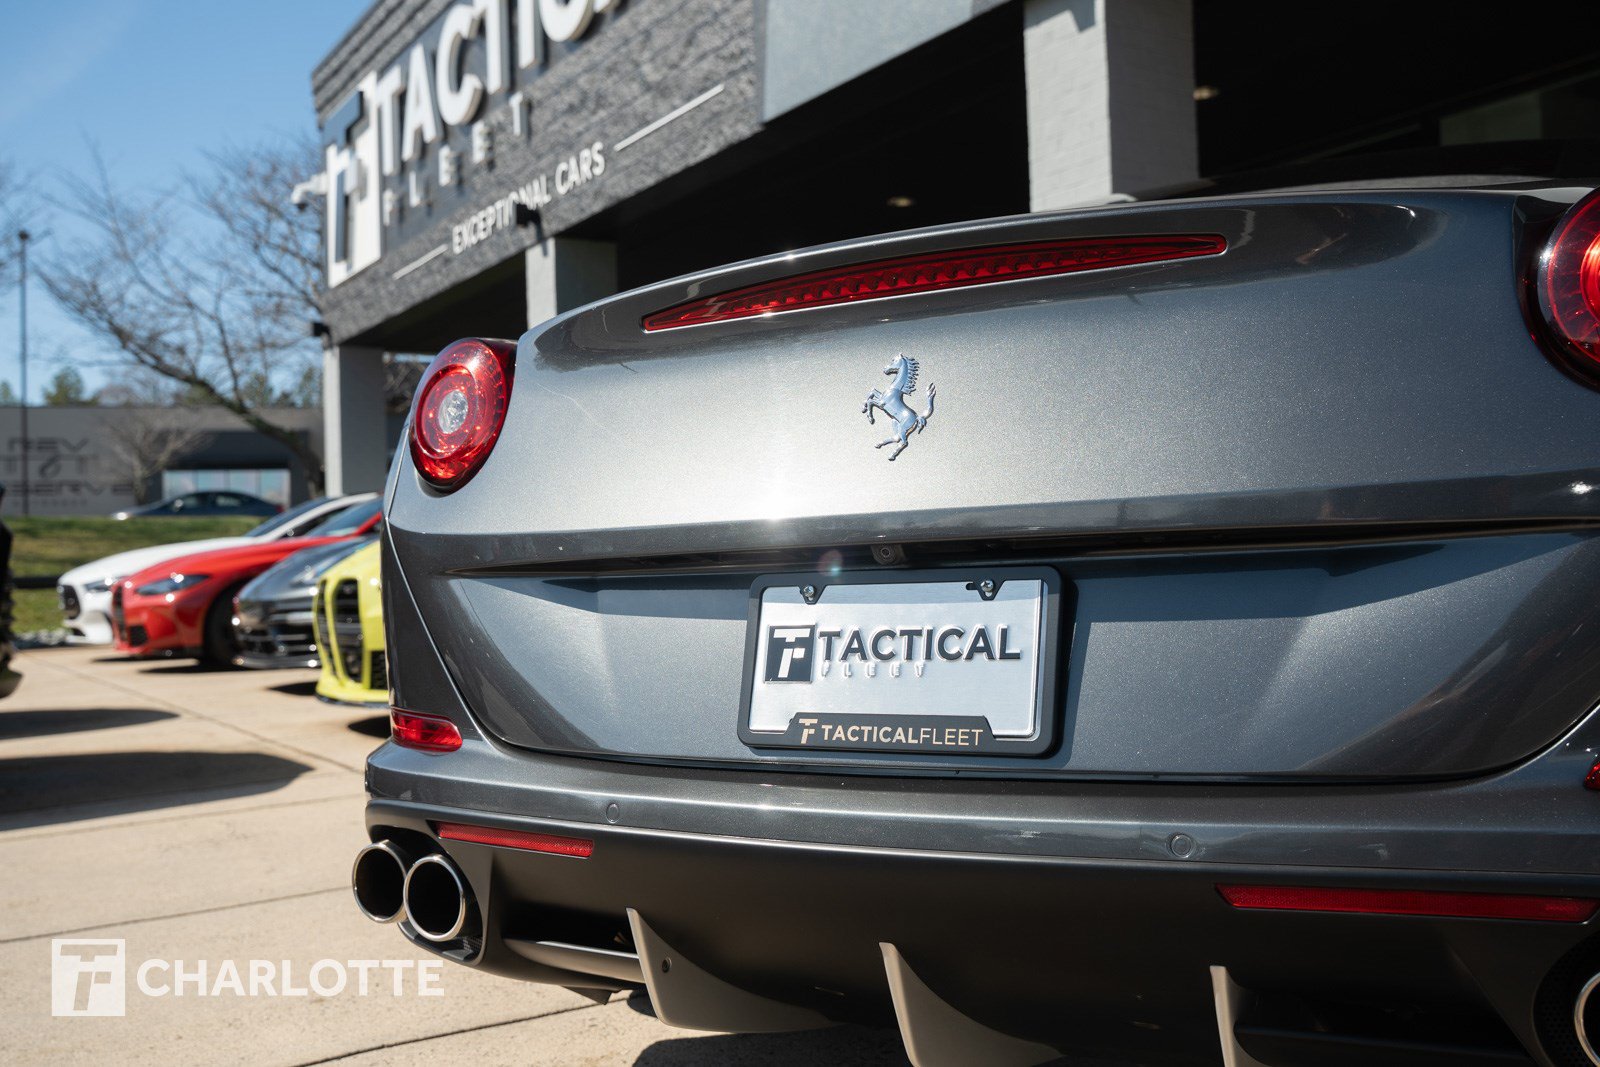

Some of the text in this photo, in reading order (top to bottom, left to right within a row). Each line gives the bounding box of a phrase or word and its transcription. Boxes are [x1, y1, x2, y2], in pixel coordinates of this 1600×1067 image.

[377, 0, 611, 176] TACTI
[383, 91, 524, 227] FLEET
[555, 141, 605, 195] CARS
[818, 625, 1021, 661] TACTICAL
[821, 660, 925, 678] FLEET
[821, 724, 983, 746] TACTICALFLEET
